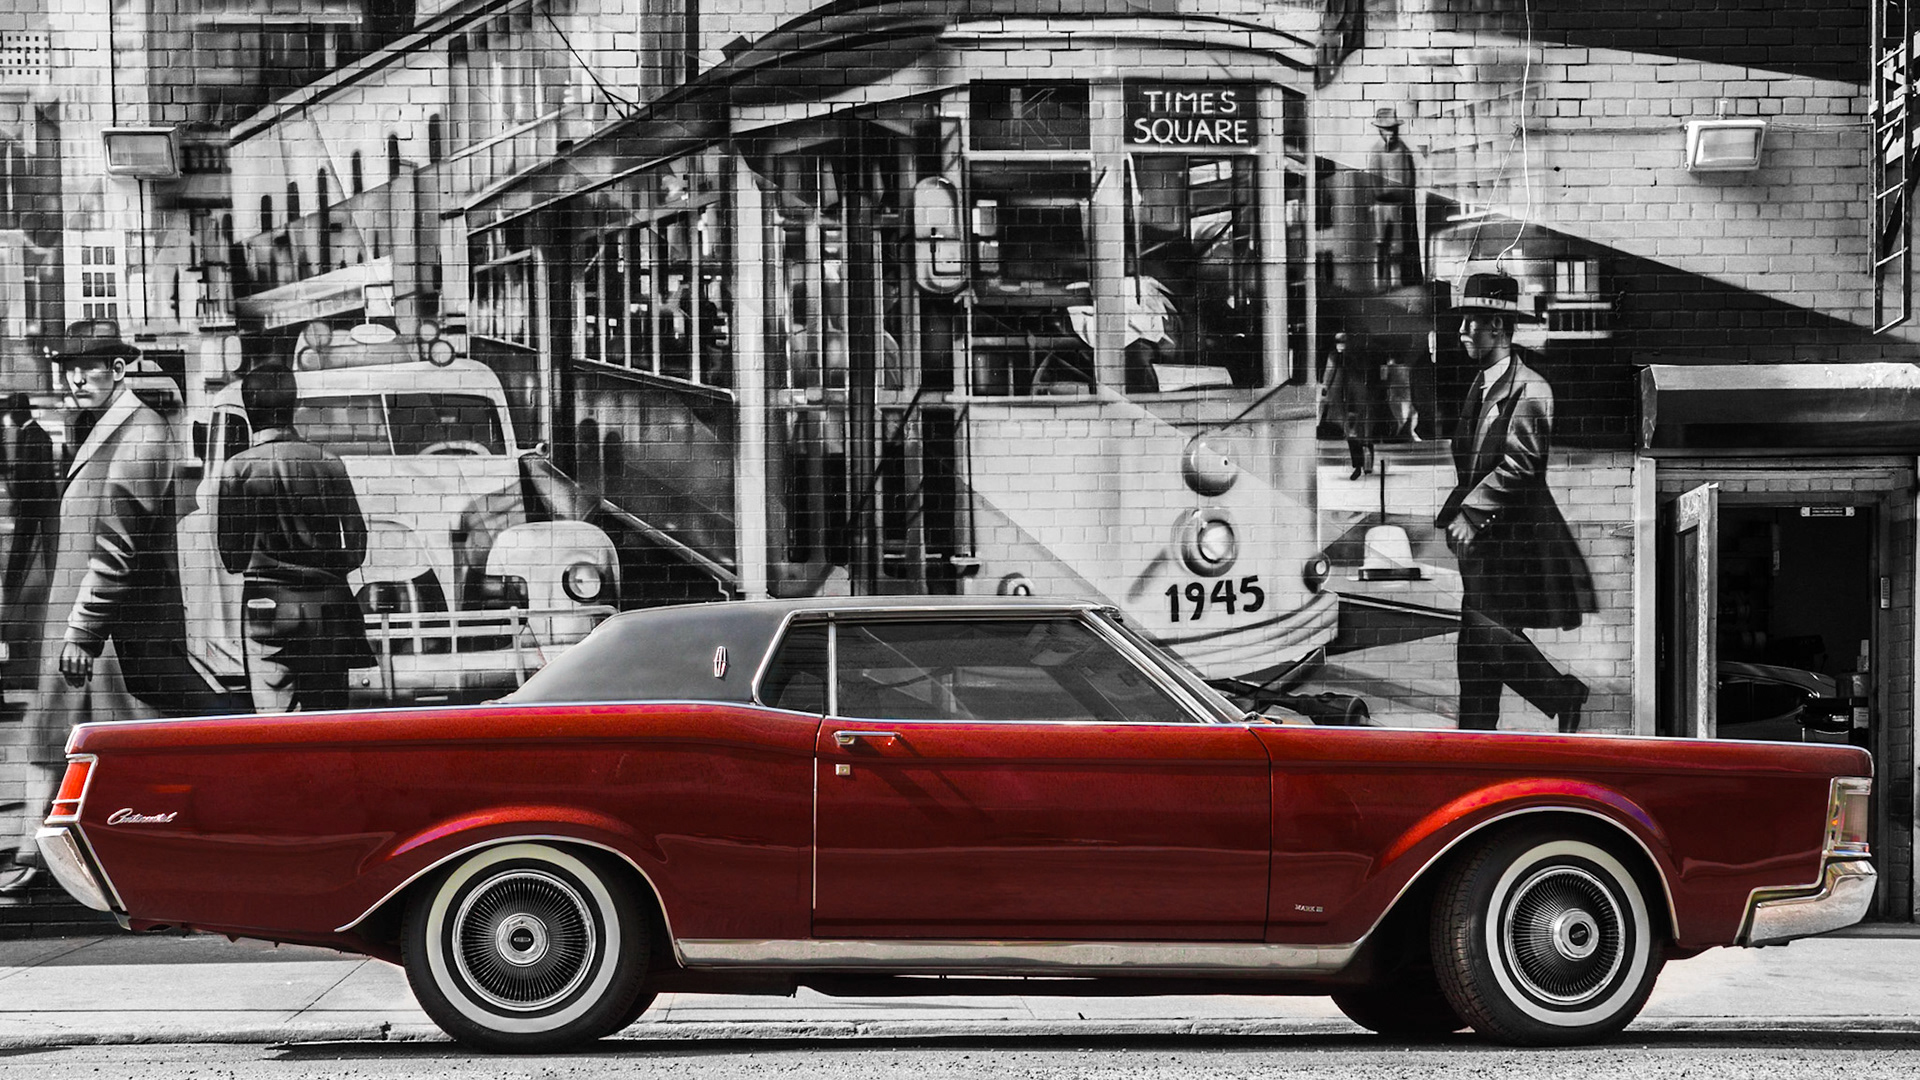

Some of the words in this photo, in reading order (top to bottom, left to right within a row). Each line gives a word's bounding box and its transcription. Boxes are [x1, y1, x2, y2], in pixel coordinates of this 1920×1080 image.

[1143, 90, 1236, 114] TIMES
[1133, 117, 1248, 144] SQUARE
[1164, 574, 1265, 622] 1945
